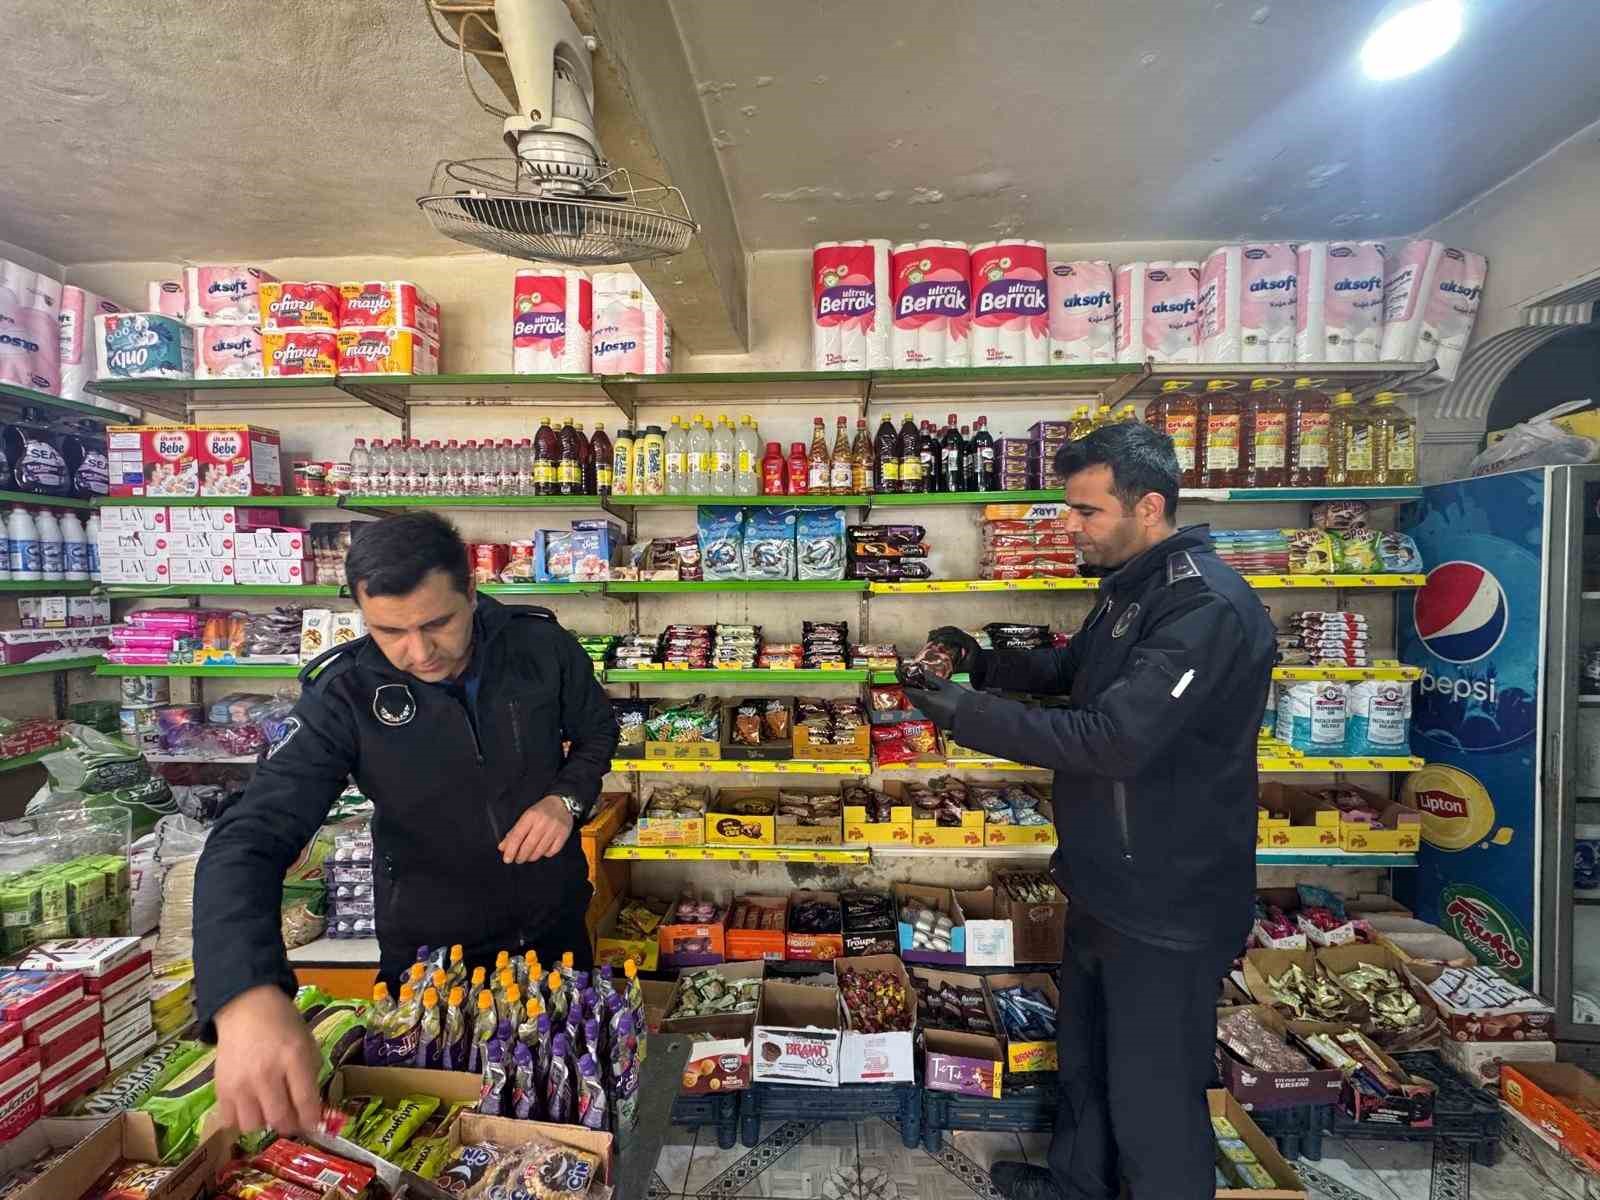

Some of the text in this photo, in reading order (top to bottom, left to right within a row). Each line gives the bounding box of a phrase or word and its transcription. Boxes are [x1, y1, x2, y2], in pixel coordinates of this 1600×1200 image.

[208, 278, 248, 295] aksoft
[928, 285, 958, 296] ultra
[1008, 284, 1036, 295] ultra
[1334, 276, 1382, 292] aksoft
[842, 287, 865, 298] ultra
[1064, 290, 1112, 308] aksoft
[820, 293, 876, 314] Berrak
[900, 291, 966, 314] Berrak
[980, 291, 1046, 312] Berrak
[1152, 299, 1197, 314] aksoft
[534, 315, 557, 324] ultra
[514, 321, 566, 336] Berrak
[212, 337, 252, 353] aksoft
[594, 340, 637, 356] aksoft
[160, 441, 184, 454] Bebe
[212, 441, 236, 455] Bebe
[1419, 671, 1496, 703] pepsi
[1420, 794, 1463, 814] Lipton
[846, 937, 876, 948] Troupe
